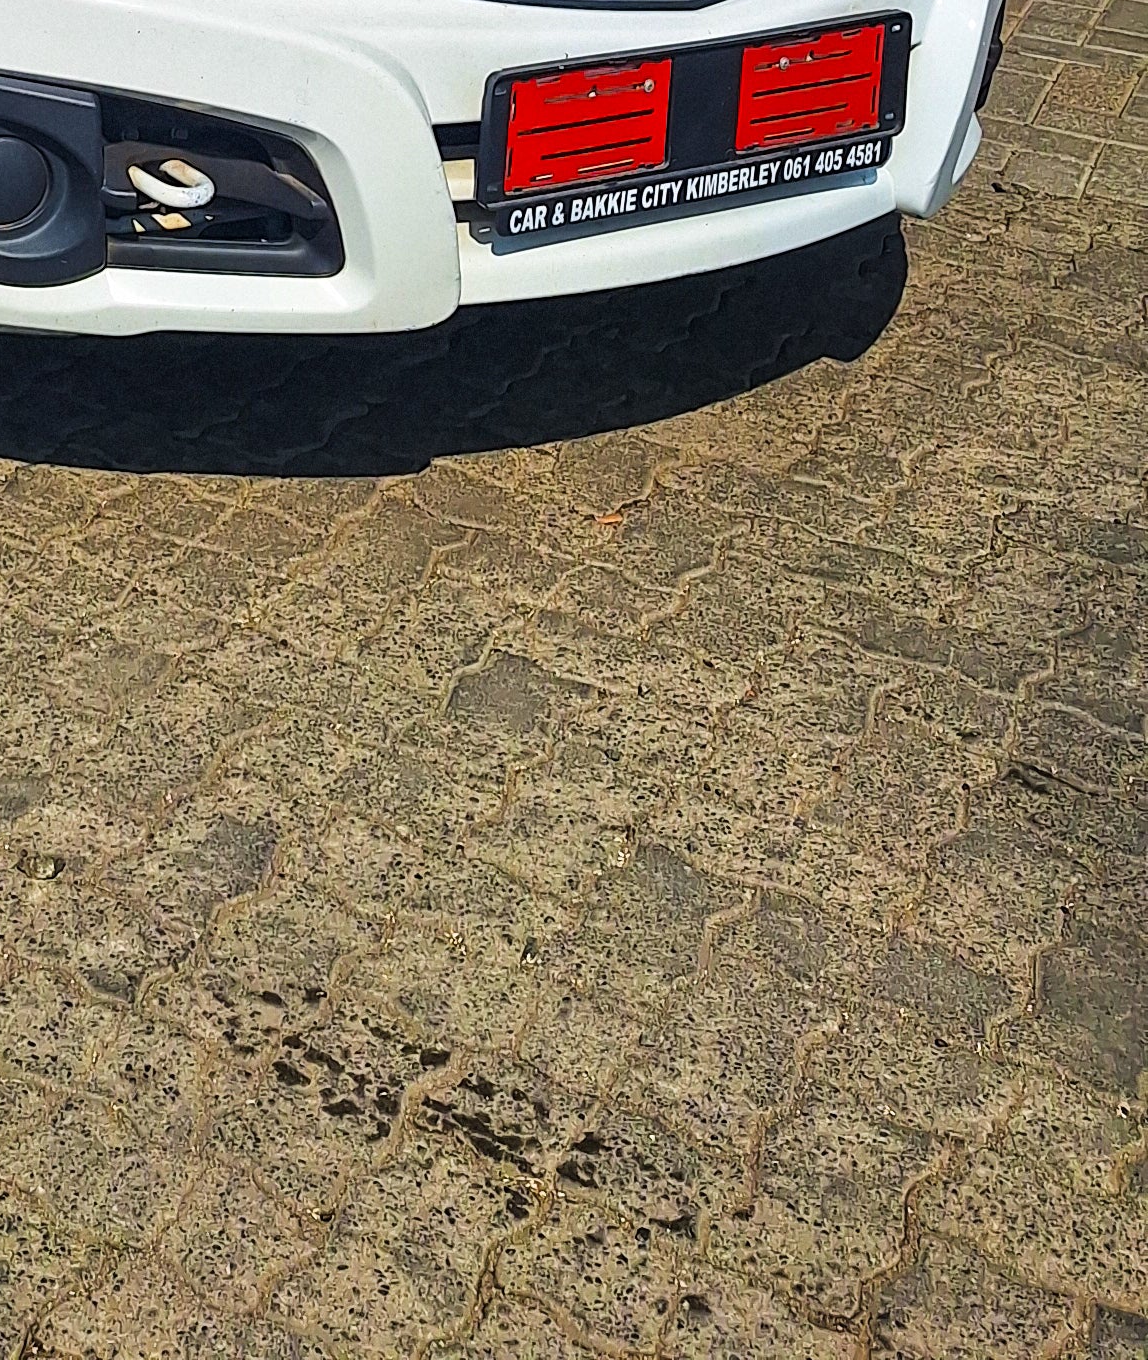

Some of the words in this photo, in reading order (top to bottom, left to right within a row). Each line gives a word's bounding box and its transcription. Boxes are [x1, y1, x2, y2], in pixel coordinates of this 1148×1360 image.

[509, 205, 548, 234] CAR
[552, 202, 565, 226] &
[570, 188, 638, 223] BAKKIE
[641, 179, 684, 209] CITY
[685, 160, 782, 201] KIMBERLEY
[783, 155, 811, 181] 061
[814, 148, 844, 174] 405
[846, 140, 883, 167] 4581
